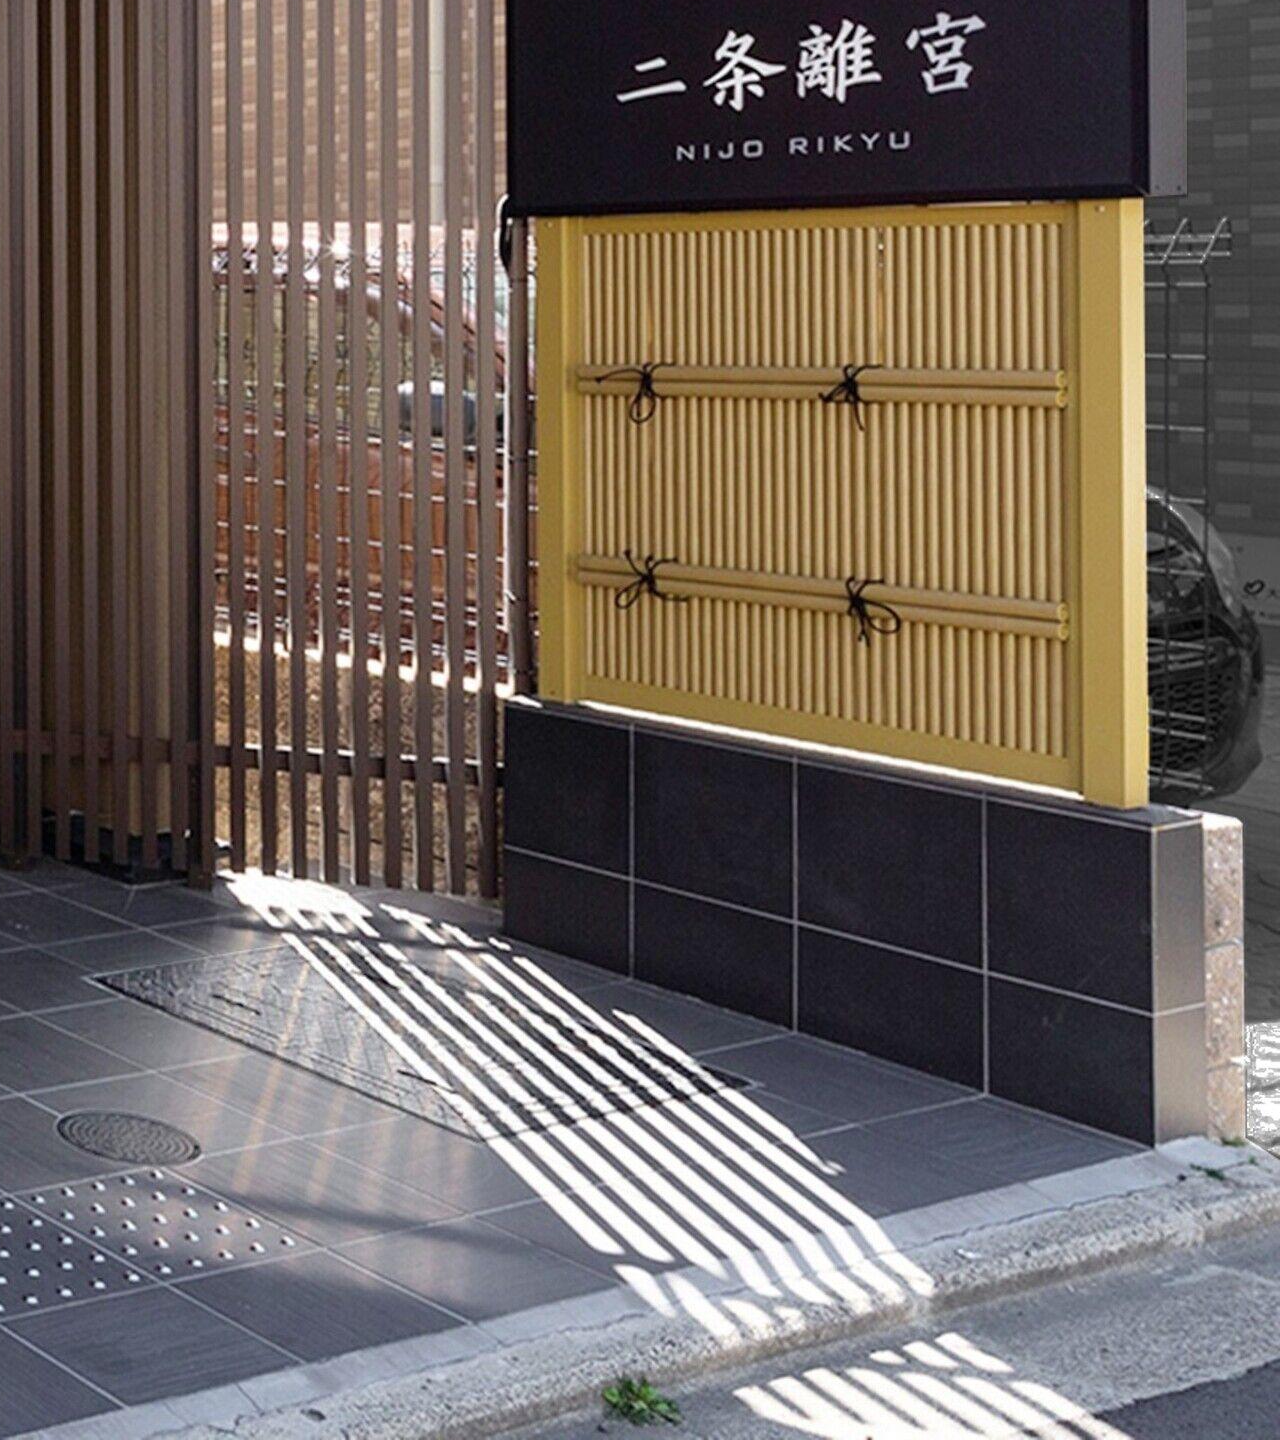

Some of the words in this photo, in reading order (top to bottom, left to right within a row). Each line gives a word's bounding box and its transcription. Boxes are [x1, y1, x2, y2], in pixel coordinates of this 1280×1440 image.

[616, 11, 987, 112] 二条離宮
[675, 139, 764, 162] NIJO
[788, 130, 912, 155] RIKYU
